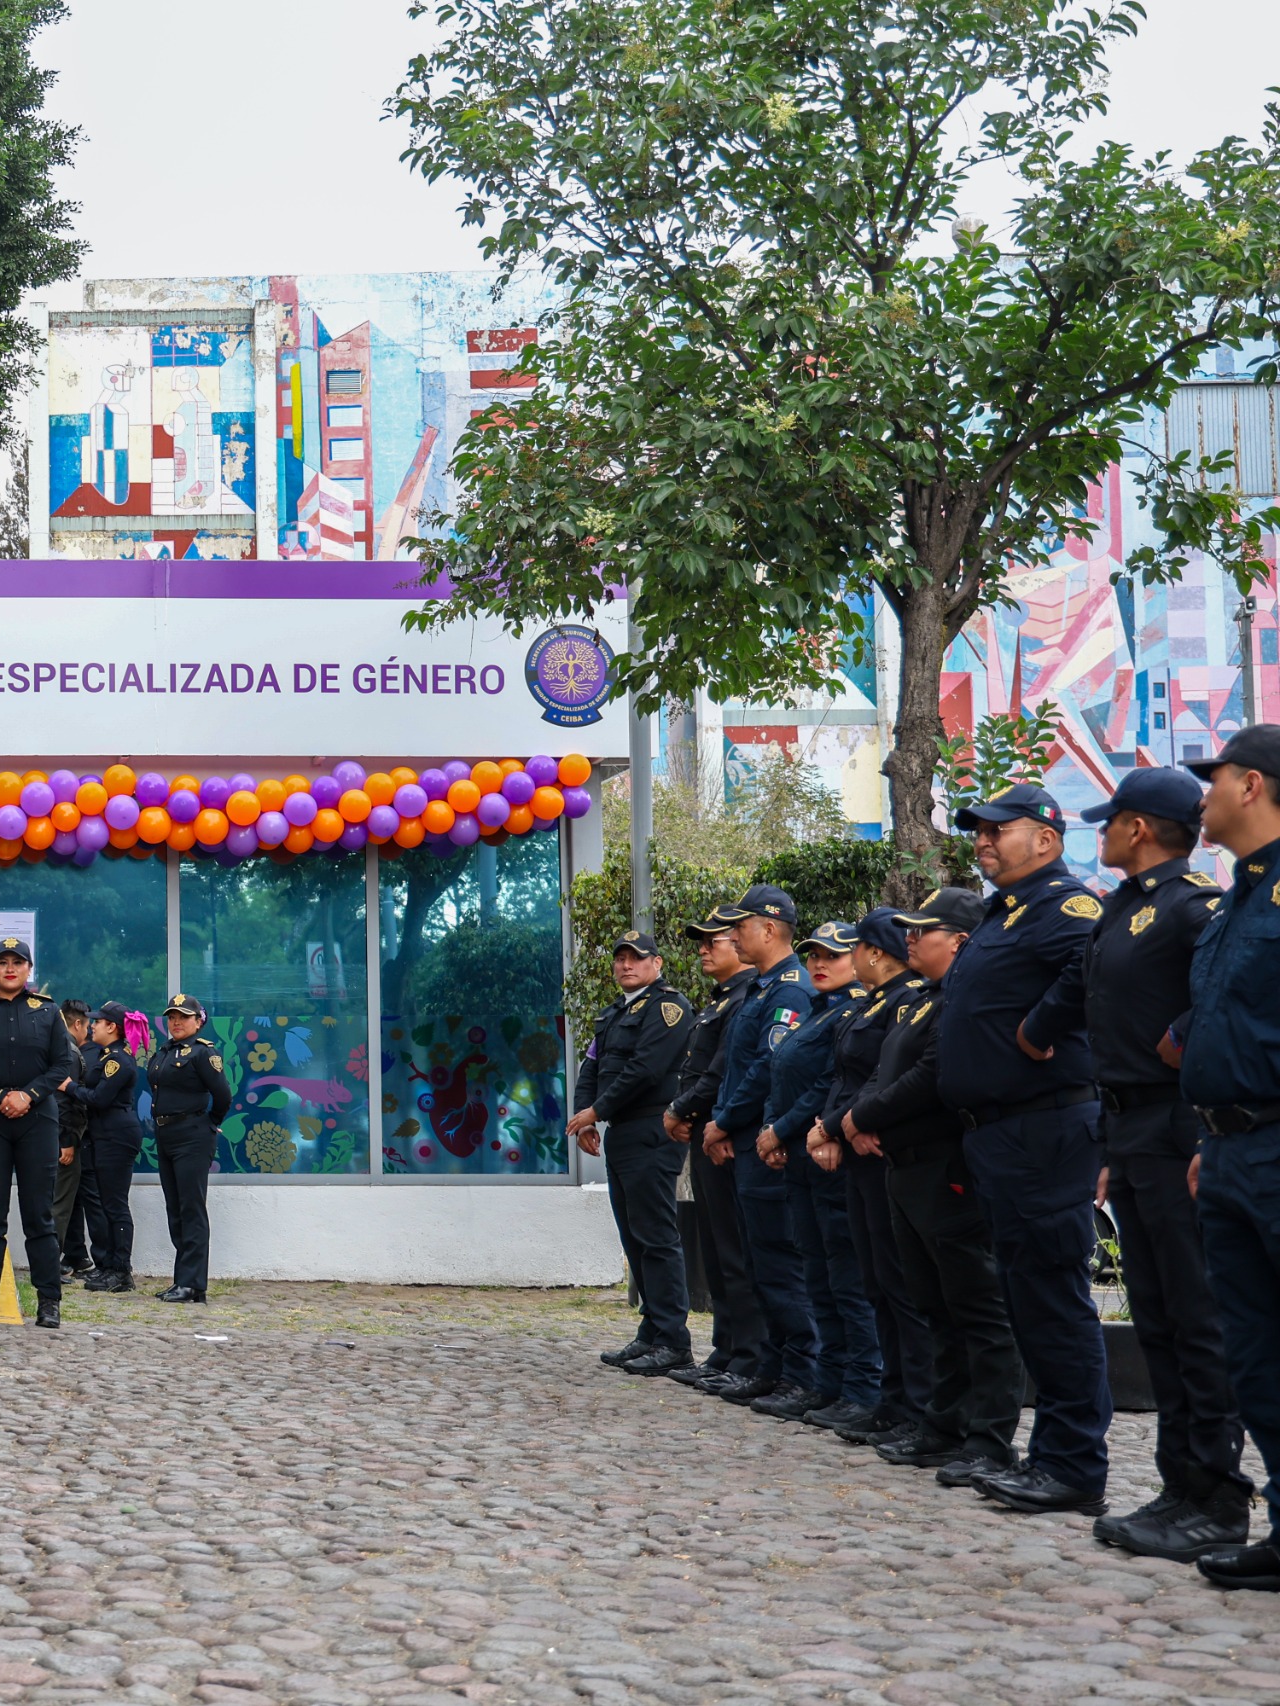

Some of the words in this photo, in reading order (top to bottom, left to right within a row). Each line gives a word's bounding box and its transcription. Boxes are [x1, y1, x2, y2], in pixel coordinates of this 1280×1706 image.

[293, 663, 340, 693] DE
[352, 656, 505, 695] GÉNERO
[533, 684, 550, 703] UNIDAD
[548, 701, 589, 712] ESPECIALIZADA
[595, 684, 610, 703] GÉNERO
[1248, 864, 1265, 873] SSC
[765, 904, 780, 912] SSC
